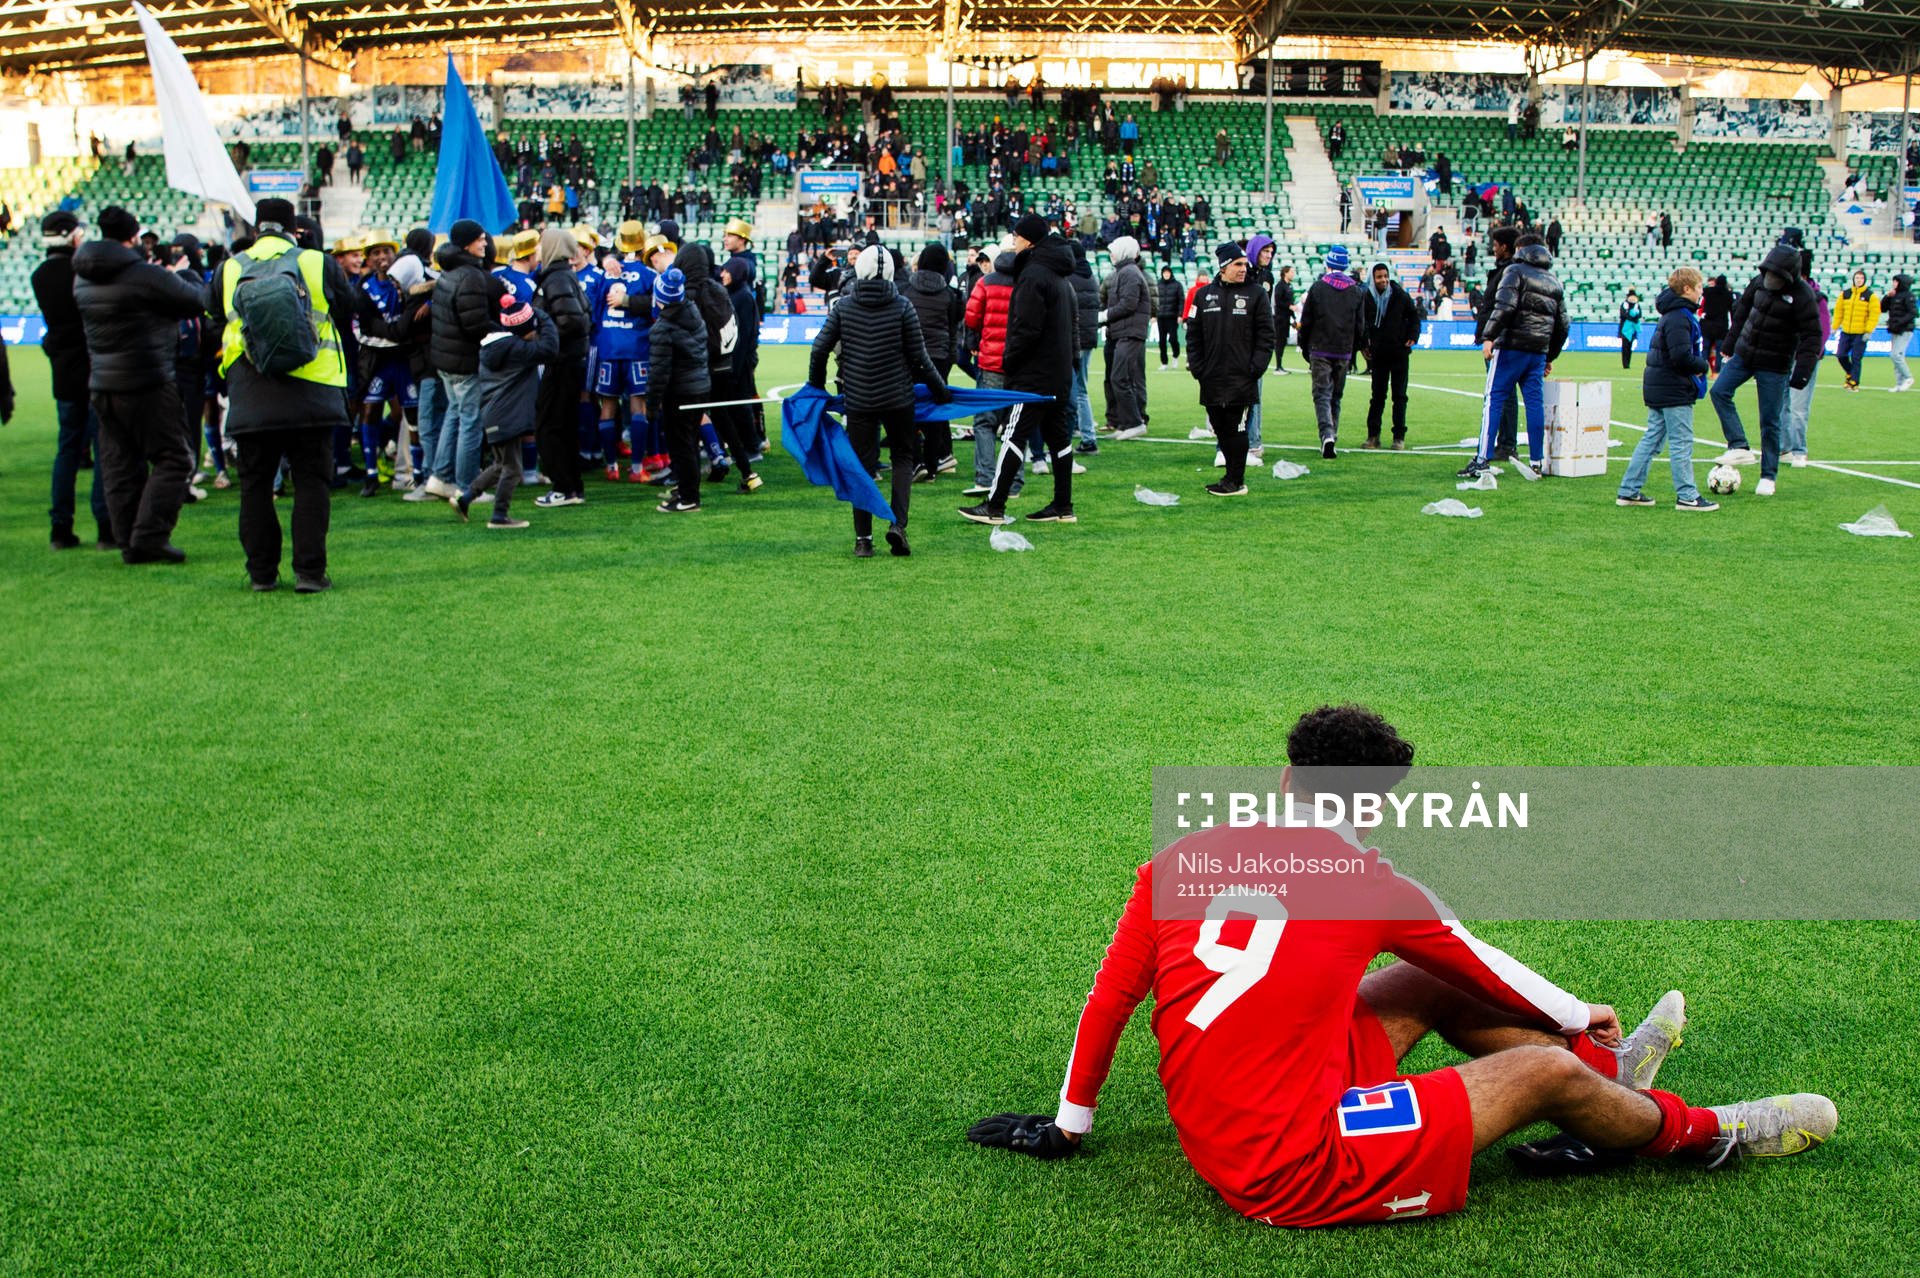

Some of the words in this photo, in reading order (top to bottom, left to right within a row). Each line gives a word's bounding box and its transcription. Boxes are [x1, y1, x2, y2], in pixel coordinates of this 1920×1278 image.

[1273, 82, 1291, 91] ALL
[1307, 82, 1325, 91] ALL
[1342, 82, 1360, 91] ALL
[1185, 885, 1289, 1032] 9
